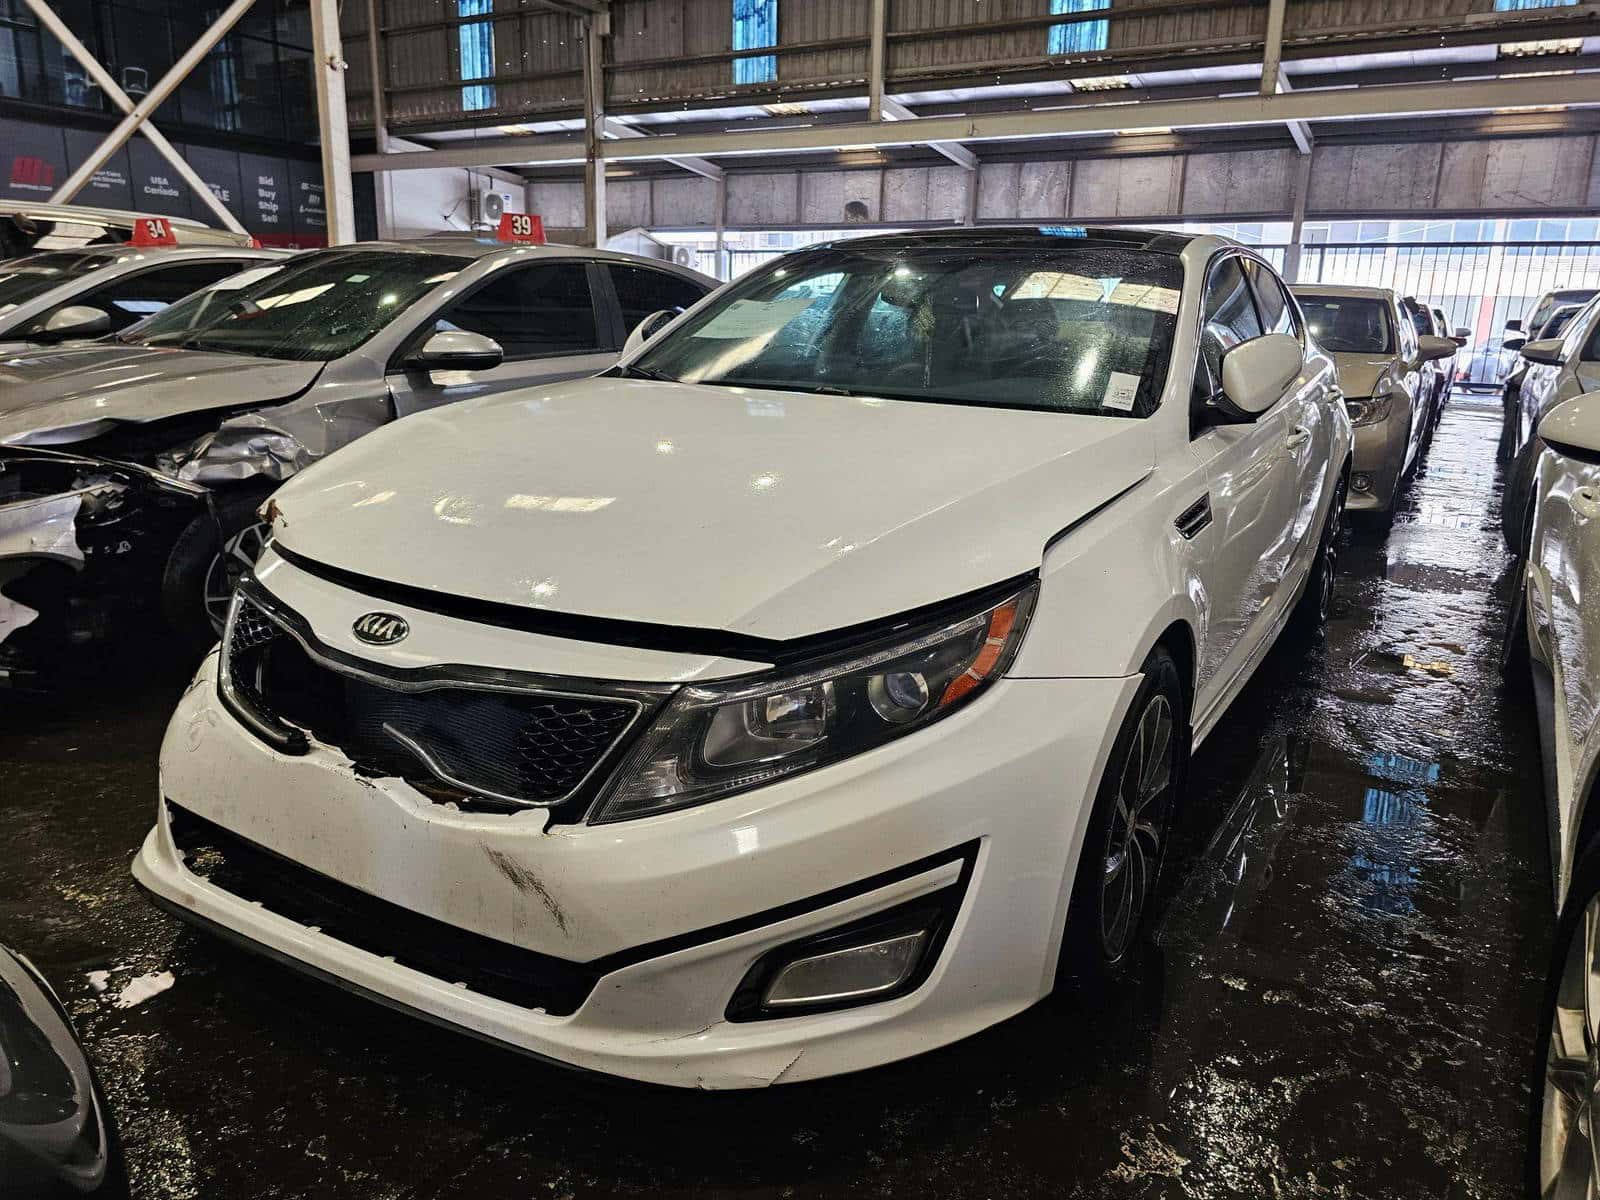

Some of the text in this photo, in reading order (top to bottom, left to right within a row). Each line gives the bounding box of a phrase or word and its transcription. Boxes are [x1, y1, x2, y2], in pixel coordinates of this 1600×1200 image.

[150, 176, 169, 186] USA
[259, 176, 274, 186] Bid
[144, 186, 179, 197] Canada
[208, 189, 230, 202] AE
[258, 188, 276, 200] Buy
[258, 201, 278, 213] Ship
[262, 214, 278, 223] Sell
[146, 219, 167, 238] 34
[512, 215, 532, 235] 39
[356, 614, 398, 640] KIA
